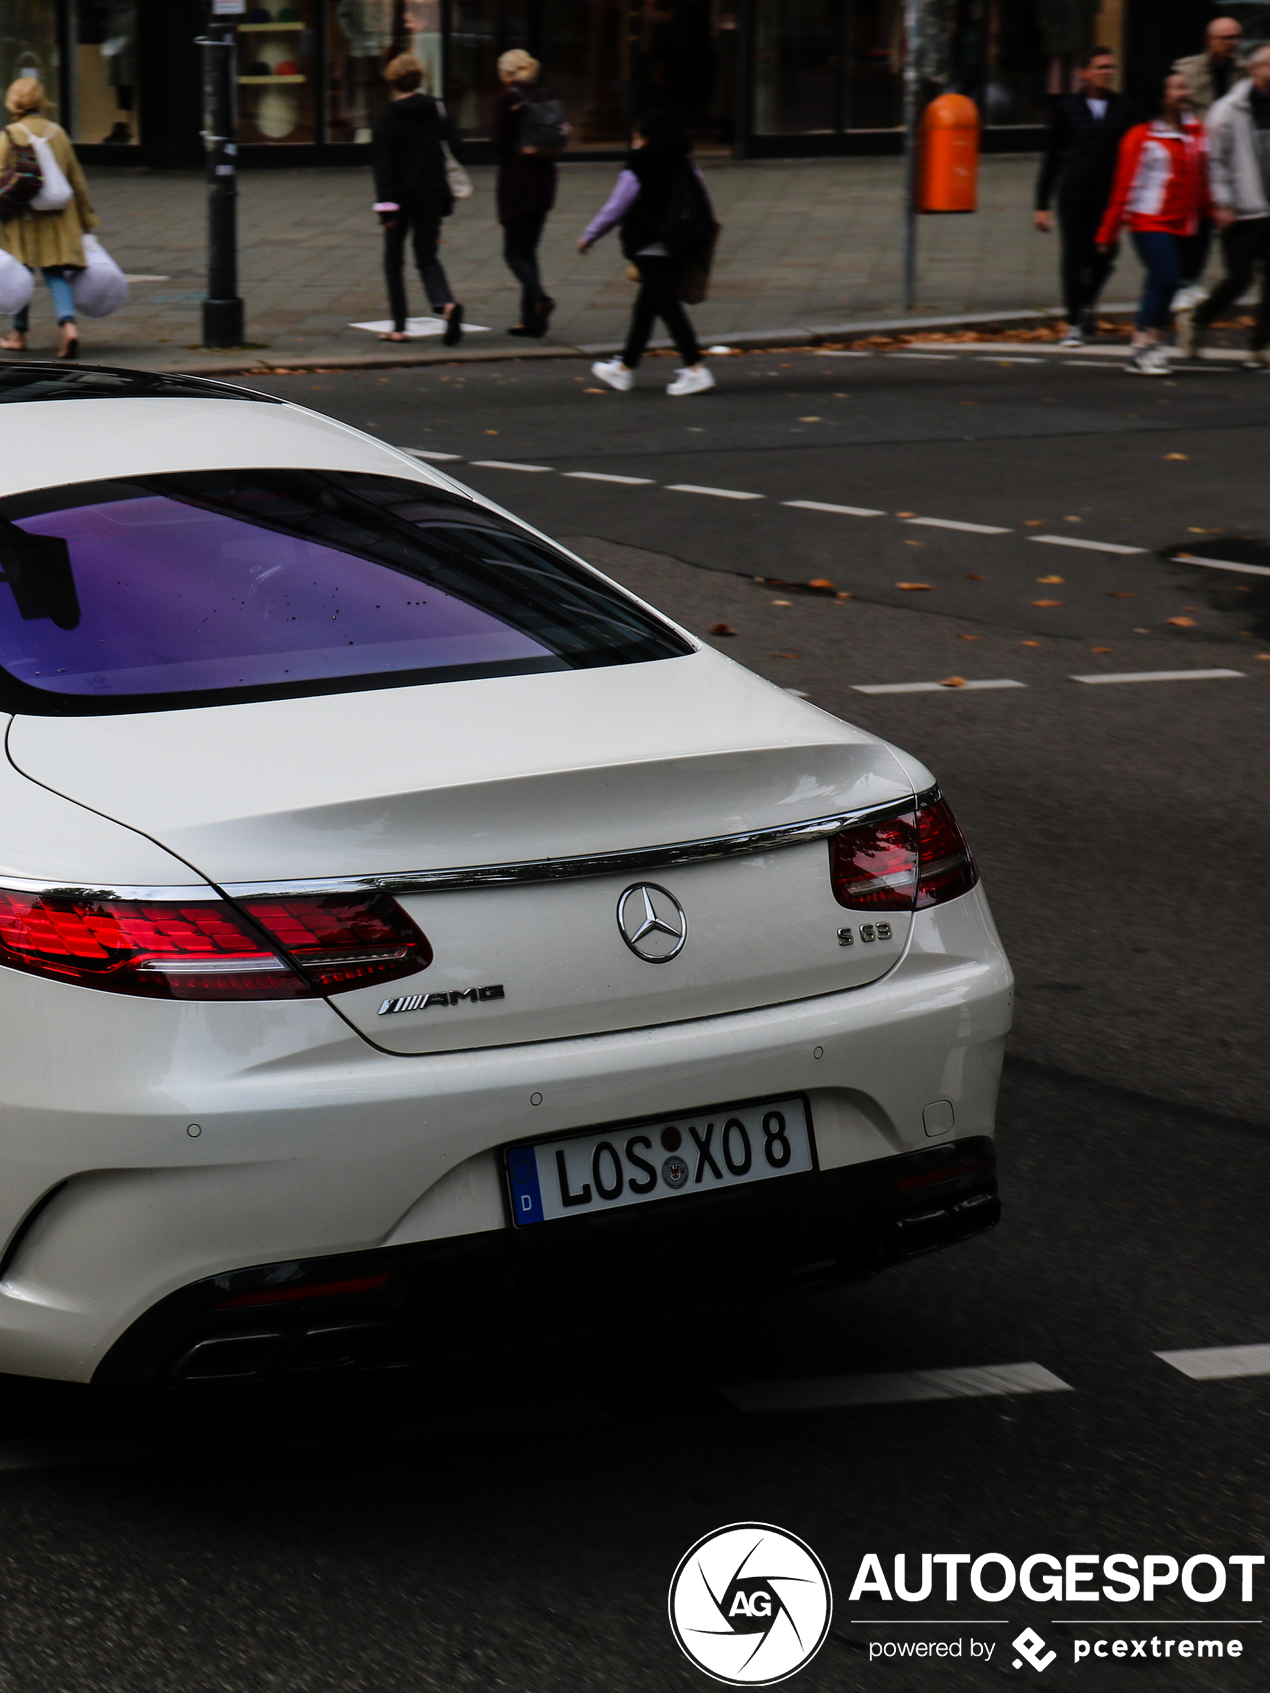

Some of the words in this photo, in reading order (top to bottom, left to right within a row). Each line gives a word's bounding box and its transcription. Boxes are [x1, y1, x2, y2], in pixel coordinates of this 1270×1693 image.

[837, 928, 854, 946] S
[859, 921, 892, 943] 63
[521, 1194, 533, 1212] D
[555, 1135, 658, 1208] LOS
[688, 1117, 752, 1184] XO
[761, 1110, 792, 1168] 8
